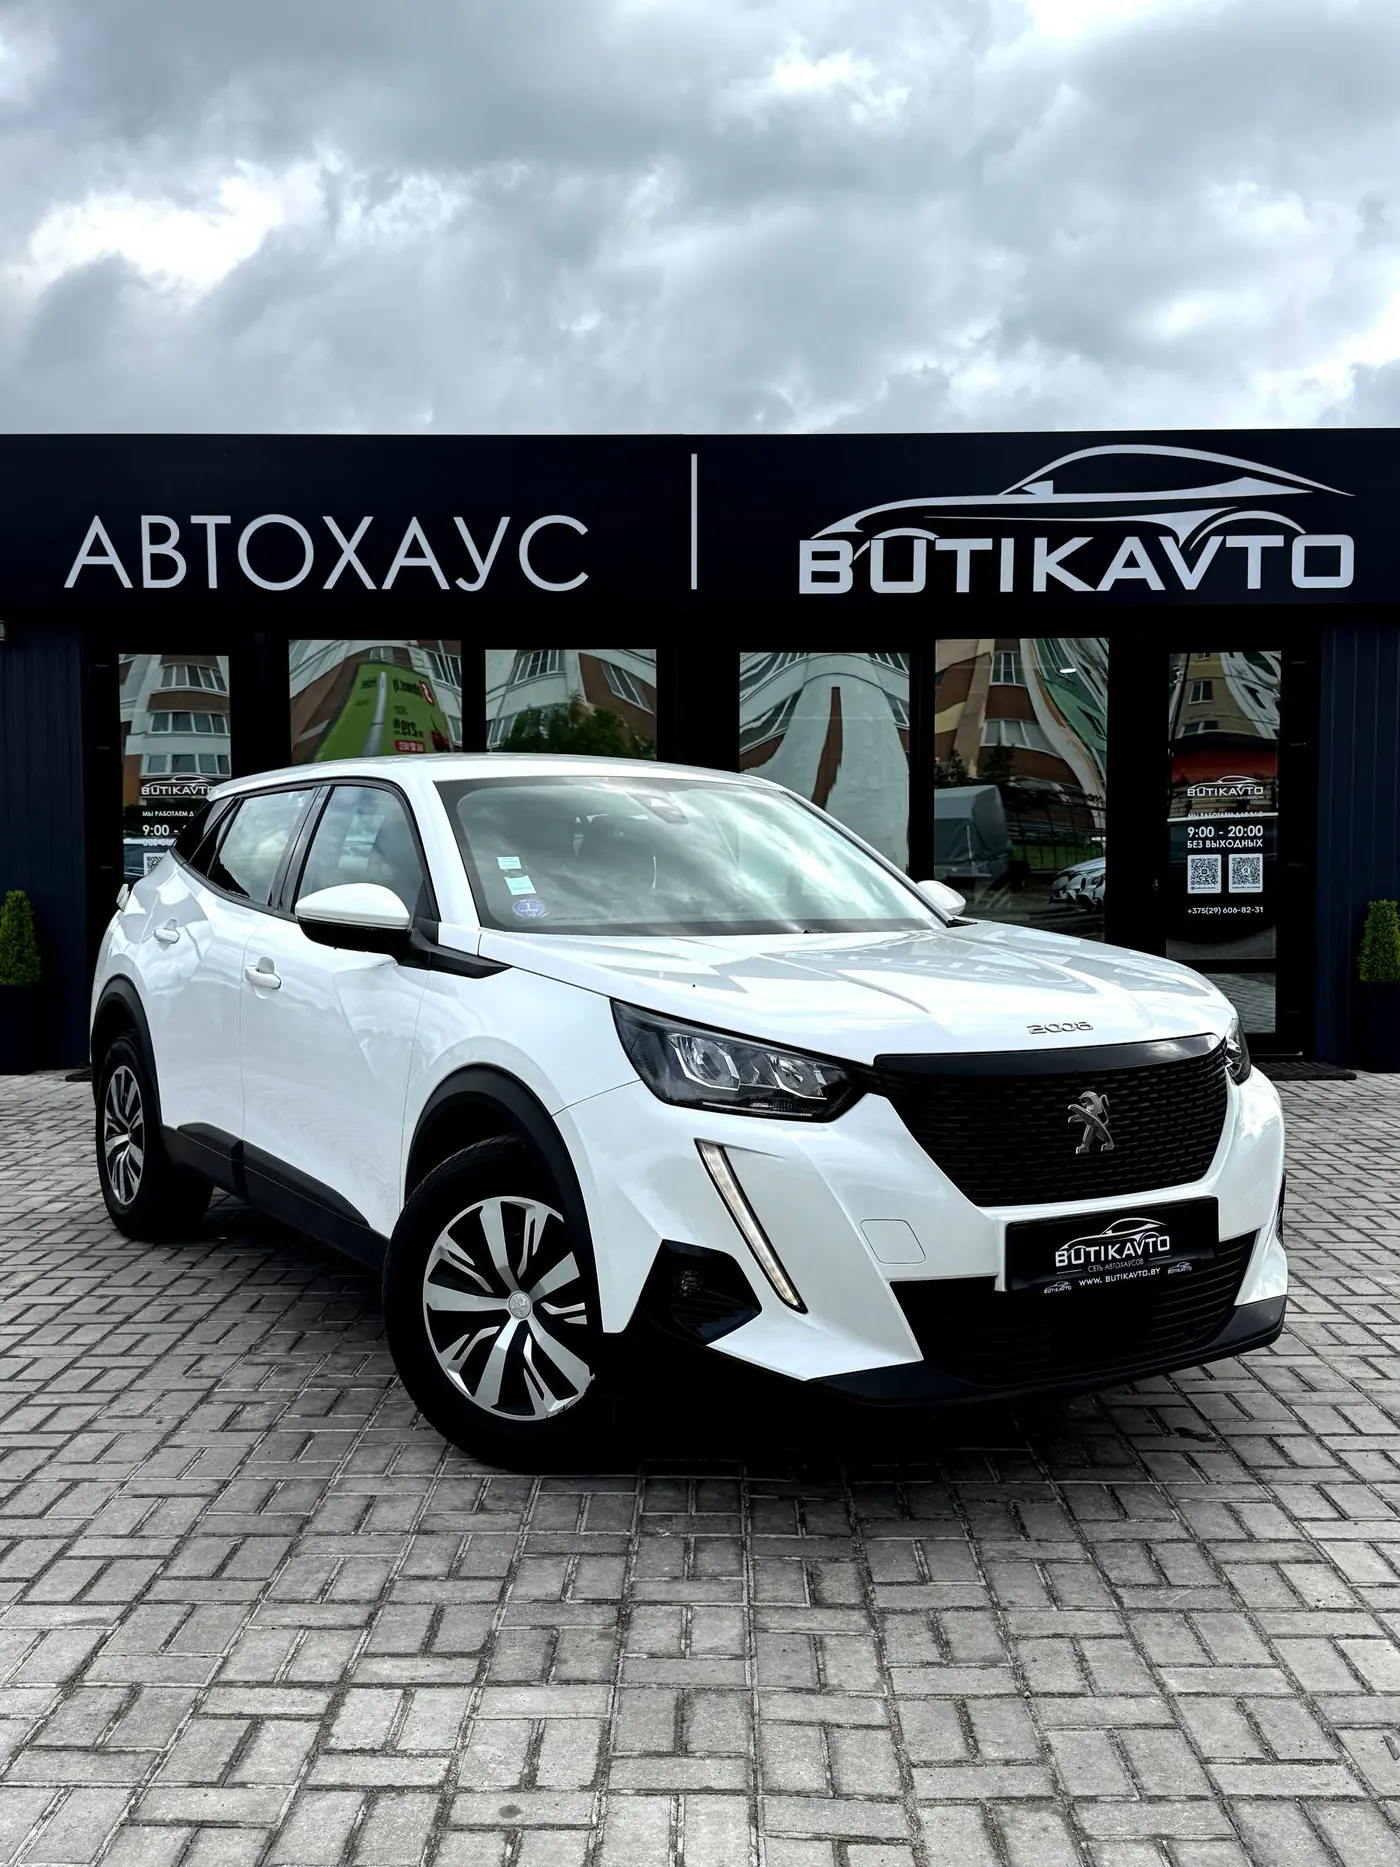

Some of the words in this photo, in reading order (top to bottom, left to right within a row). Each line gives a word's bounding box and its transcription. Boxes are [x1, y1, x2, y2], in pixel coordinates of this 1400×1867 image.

[64, 514, 589, 592] АВТОХАУС
[799, 534, 1355, 595] BUTIKAVTO
[1187, 786, 1264, 797] BUTIKAVTO
[142, 824, 170, 836] 9:00
[1187, 826, 1215, 838] 9:00
[1227, 825, 1264, 837] 20:00
[1187, 840, 1203, 849] БЕЗ
[1205, 838, 1264, 849] ВЫХОДНЫХ
[1187, 907, 1222, 915] +375(29)
[1222, 906, 1264, 914] 606-82-31
[1055, 1235, 1170, 1267] BUTIKAVTO
[1088, 1264, 1104, 1273] СЕТЬ
[1104, 1258, 1145, 1271] АВТОХАУСОВ
[1078, 1277, 1103, 1287] WWW.
[1105, 1267, 1162, 1283] BUTIKAVTO.BY
